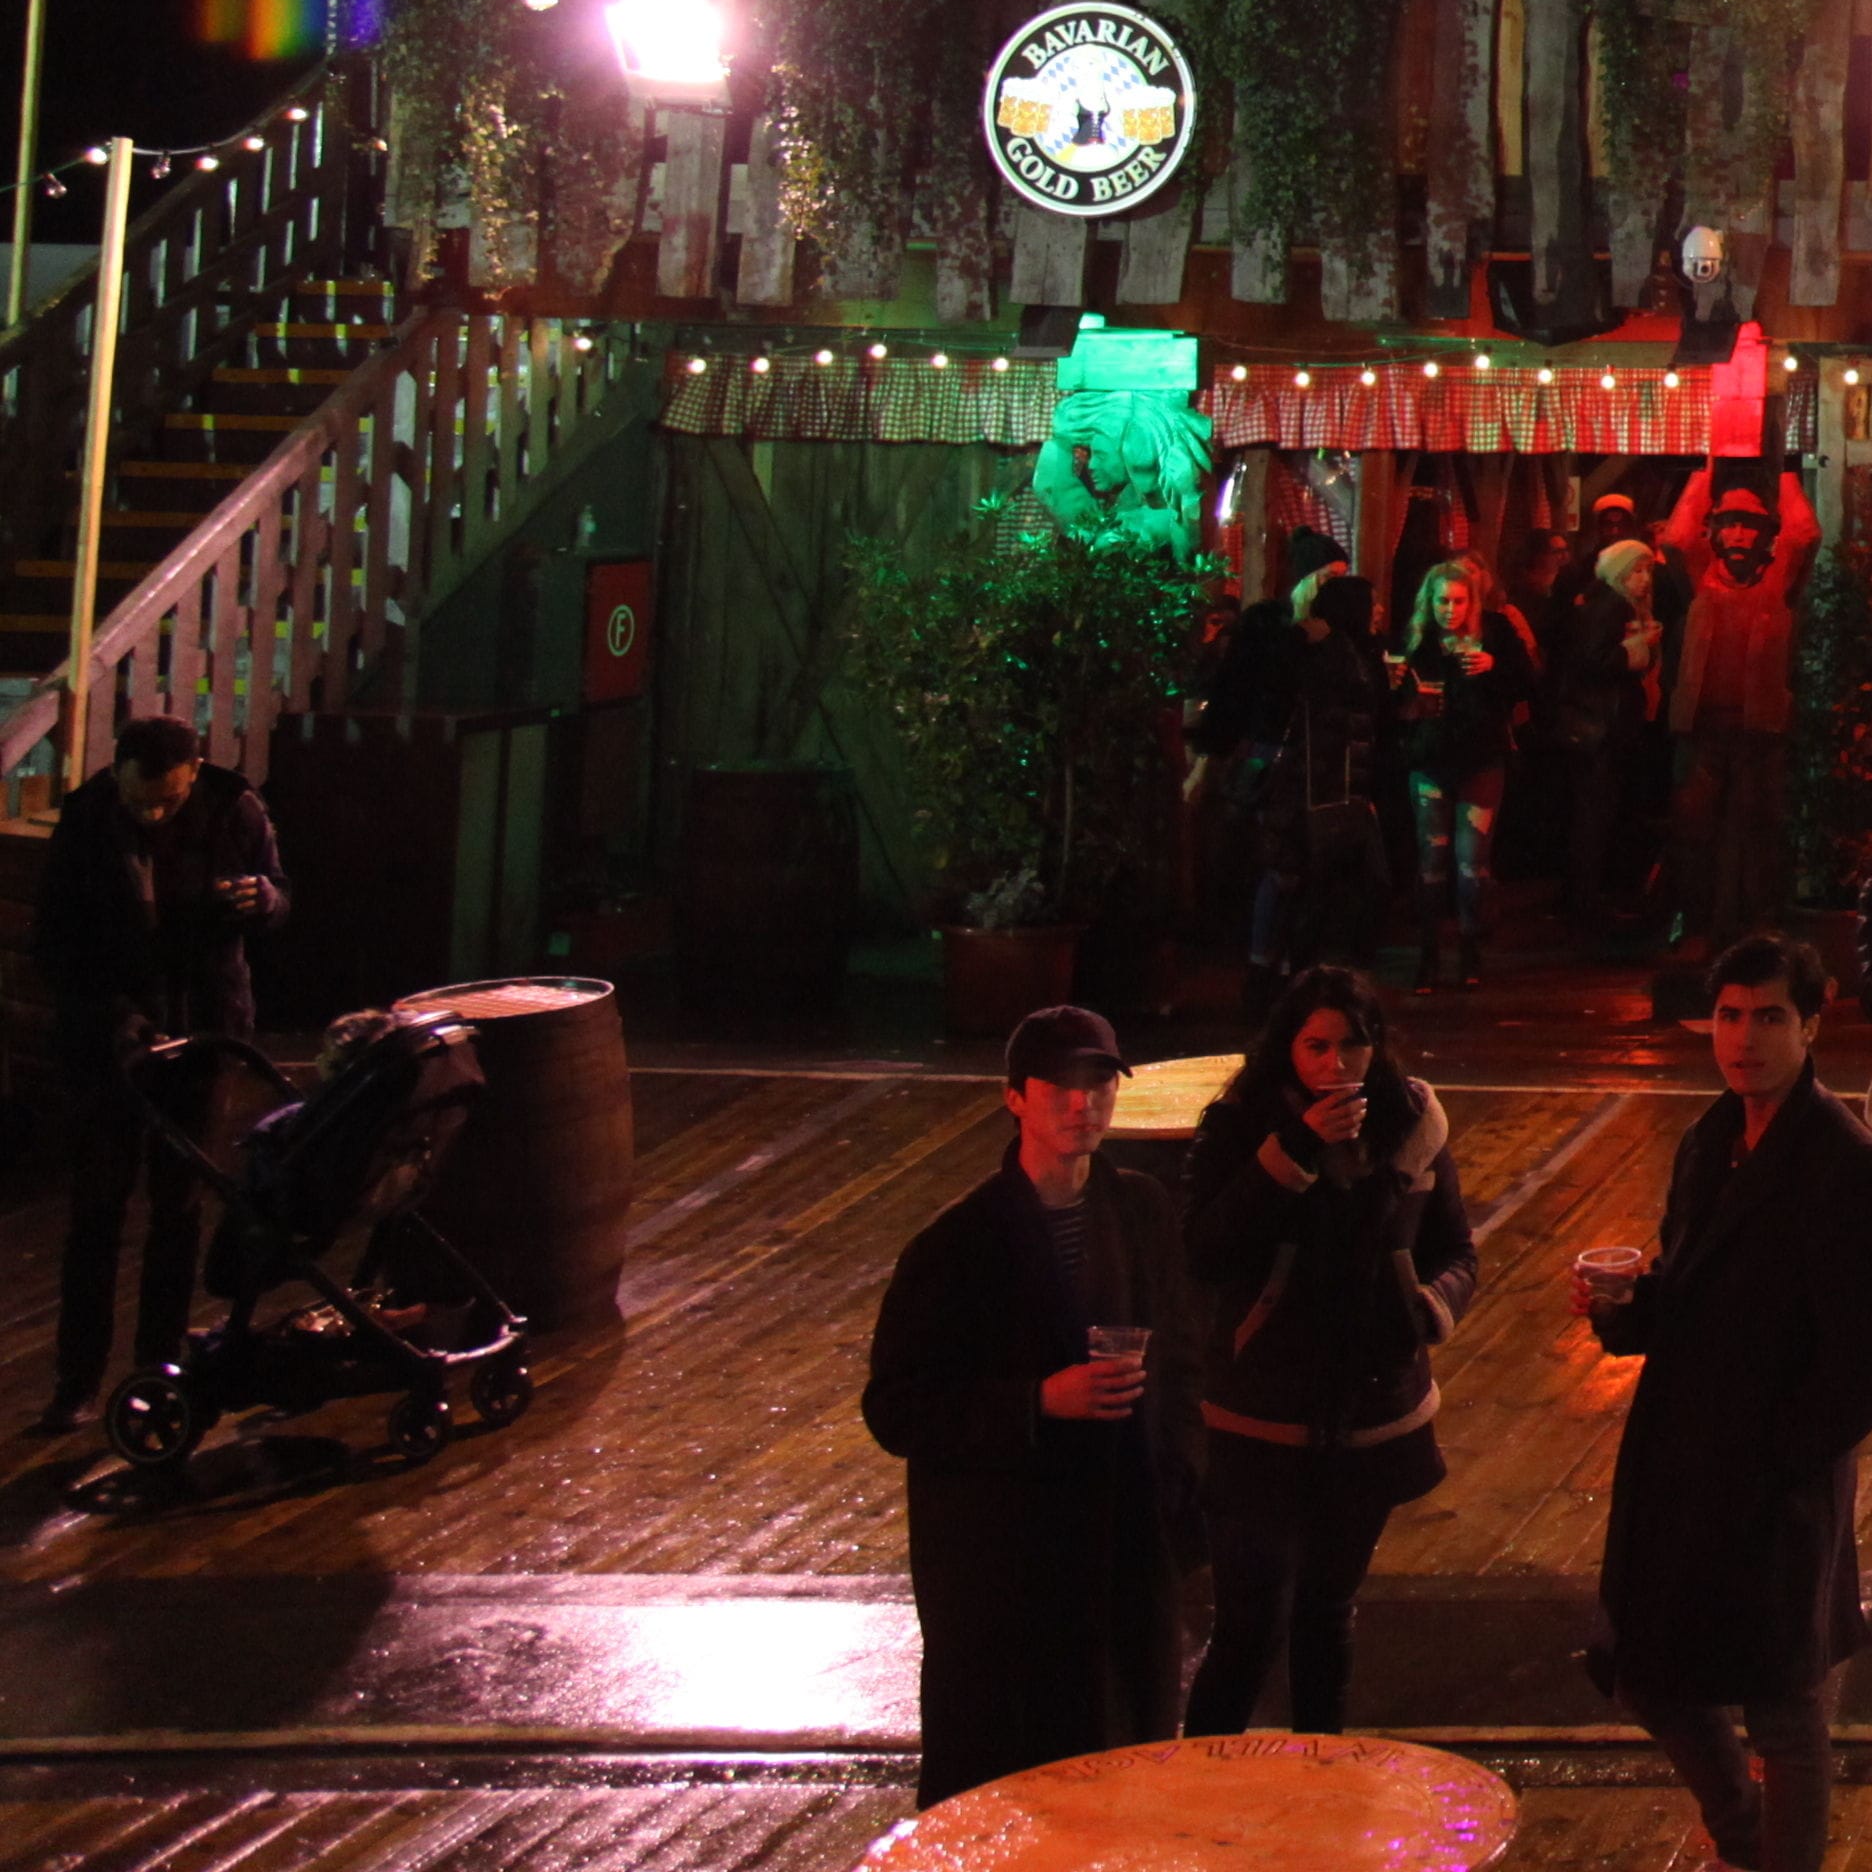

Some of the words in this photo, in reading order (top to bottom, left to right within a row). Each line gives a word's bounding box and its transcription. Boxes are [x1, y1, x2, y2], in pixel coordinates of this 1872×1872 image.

[1021, 18, 1170, 76] BAVARIAN
[1006, 137, 1079, 200] GOLD
[1090, 145, 1167, 202] BEER
